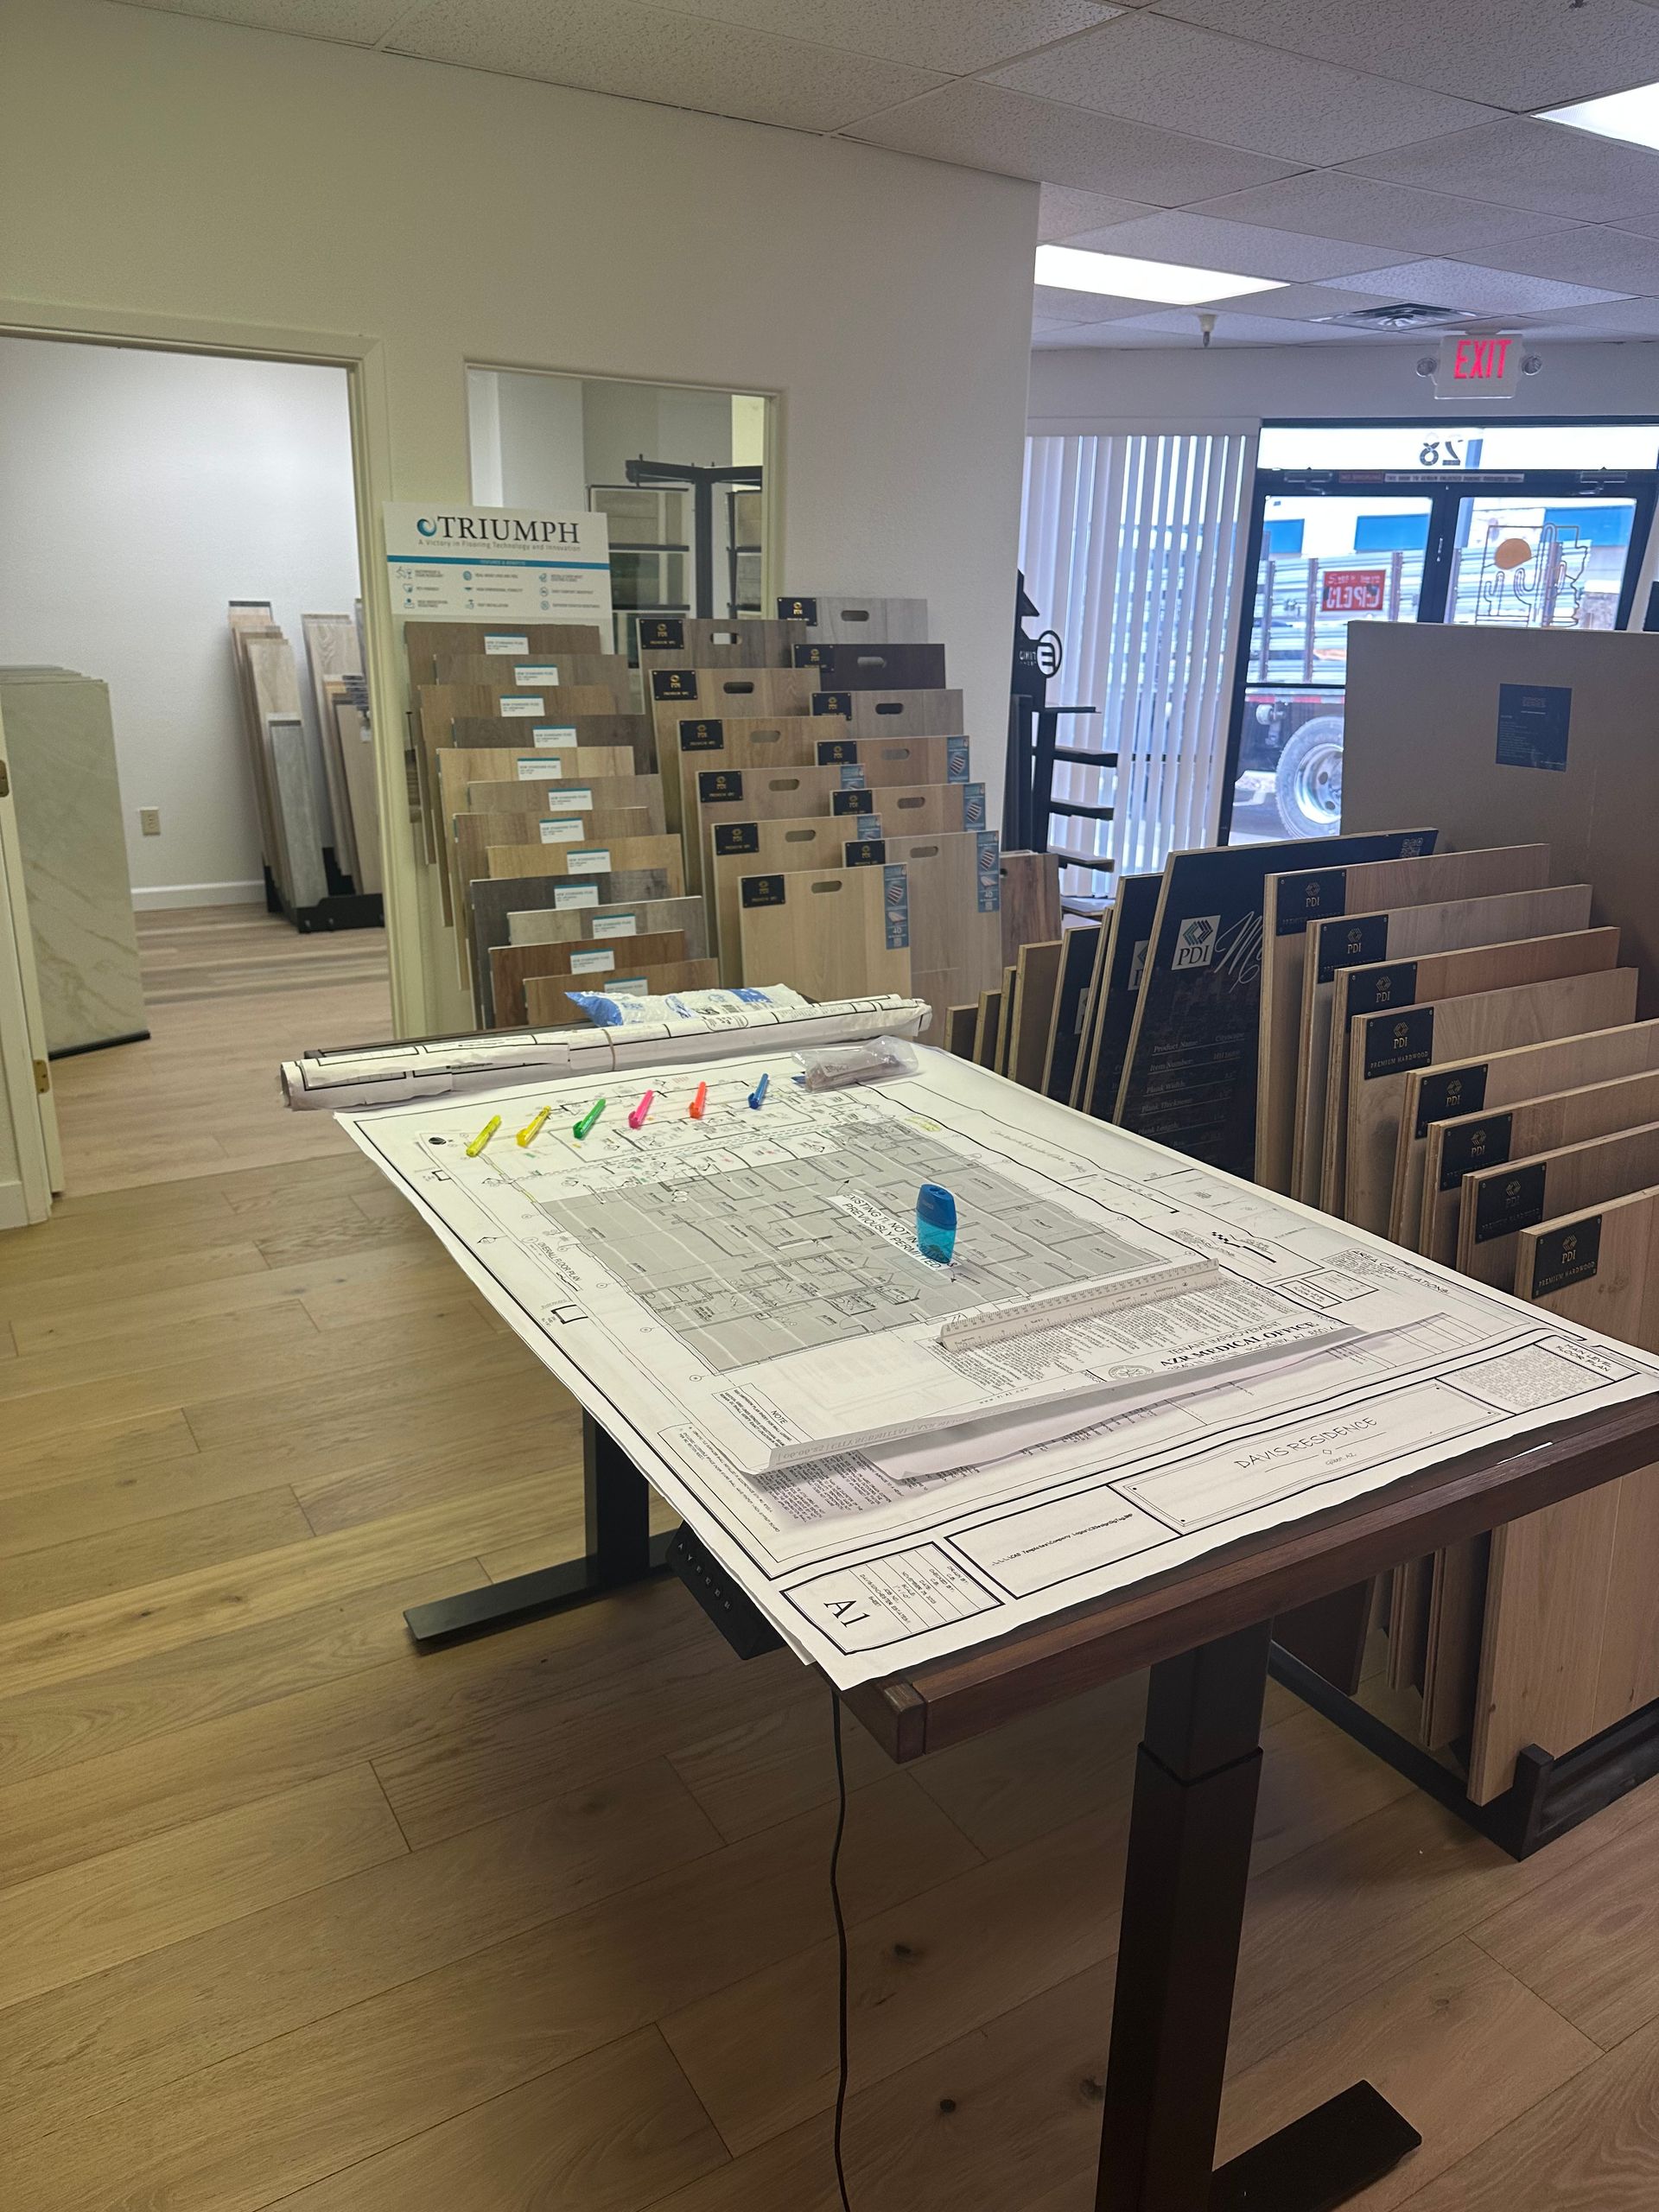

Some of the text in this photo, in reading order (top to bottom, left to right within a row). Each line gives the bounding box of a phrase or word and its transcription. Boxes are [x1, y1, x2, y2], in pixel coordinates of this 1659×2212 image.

[1453, 339, 1513, 379] EXIT
[437, 515, 580, 544] TRIUMPH
[461, 541, 491, 550] Flooring
[493, 542, 531, 551] Technology
[1306, 896, 1320, 907] PDI
[1177, 945, 1211, 966] PDI
[1347, 943, 1362, 955] PDI
[1376, 991, 1390, 1002] PDI
[1154, 1041, 1179, 1052] Product
[1393, 1037, 1408, 1049] PDI
[1149, 1064, 1166, 1072] Item
[1370, 1051, 1428, 1069] PREMIUM HARDWOOD
[1146, 1084, 1164, 1093] Plank
[1141, 1103, 1159, 1112] Plank
[1446, 1095, 1461, 1107] PDI
[1471, 1146, 1485, 1157] PDI
[842, 1192, 882, 1217] EXISTING
[888, 1220, 911, 1236] NOT
[842, 1202, 895, 1237] PREVIOUSLY
[537, 1242, 582, 1281] OVERALL FLOOR PLAN
[1354, 1249, 1378, 1263] AREA
[1561, 1249, 1576, 1263] PDI
[1538, 1261, 1595, 1287] PREMIUM HARDWOOD
[1160, 1355, 1193, 1367] AZR
[1192, 1336, 1265, 1358] MEDICAL
[1262, 1321, 1319, 1338] OFFICE
[1168, 1321, 1282, 1355] TENANT IMPROVEMENT
[1555, 1344, 1611, 1372] FLOOR PLAN
[1563, 1343, 1612, 1368] MAIN LEVEL
[770, 1410, 788, 1425] NOTE
[1234, 1417, 1377, 1469] DAVIS RESIDENCE
[929, 1568, 948, 1586] CHECKED
[947, 1566, 961, 1579] DRAWN
[901, 1571, 922, 1591] NOVEMBER
[868, 1595, 882, 1607] SHEET
[823, 1599, 871, 1628] A1
